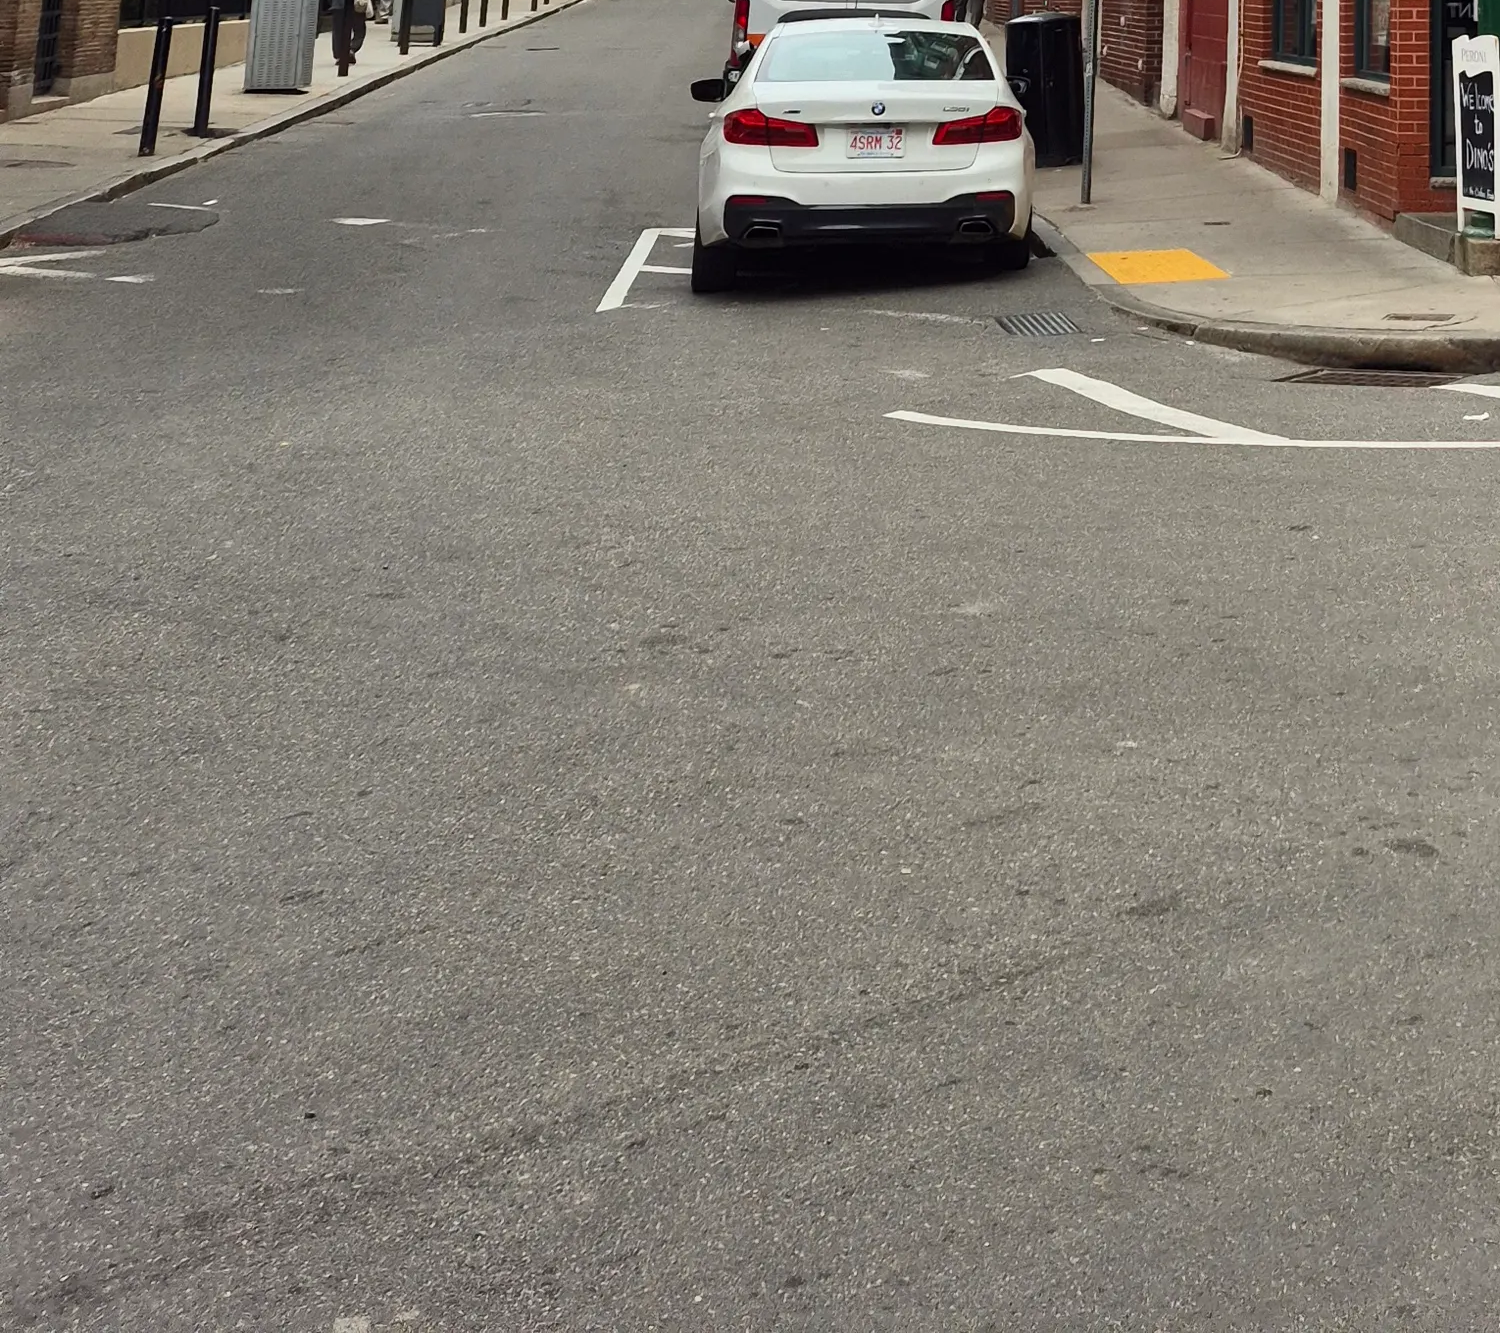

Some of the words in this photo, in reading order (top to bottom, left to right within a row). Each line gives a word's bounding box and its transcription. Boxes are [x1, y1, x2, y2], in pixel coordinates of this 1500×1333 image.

[1461, 47, 1487, 63] PERONI
[1474, 113, 1483, 134] to
[850, 135, 882, 150] 4SRM
[886, 135, 902, 149] 32
